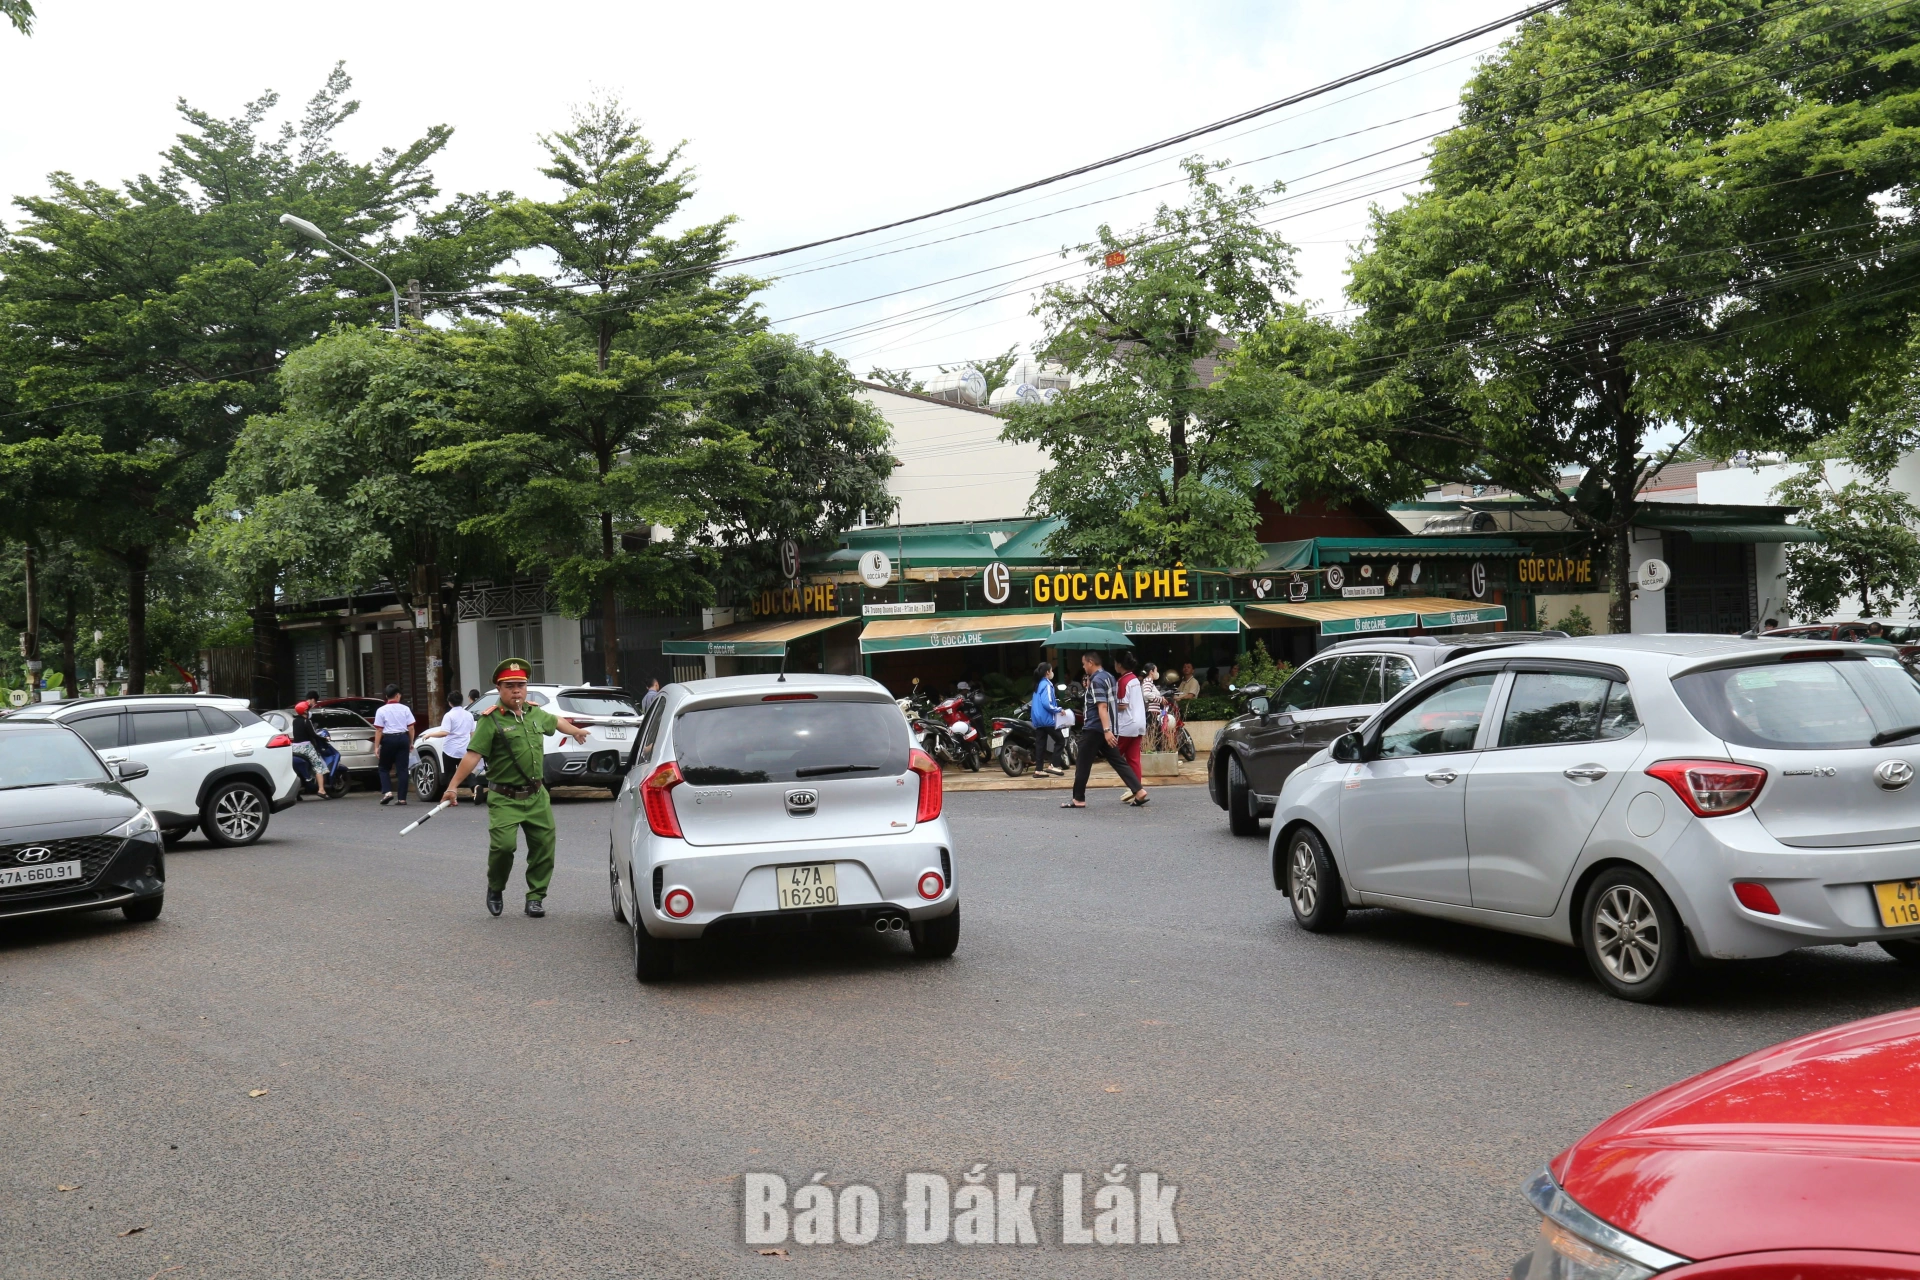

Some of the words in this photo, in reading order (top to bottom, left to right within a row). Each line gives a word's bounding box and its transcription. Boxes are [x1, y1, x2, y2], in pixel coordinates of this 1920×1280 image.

[1519, 552, 1545, 583] GÓC
[1094, 564, 1129, 600] CÀ
[1135, 561, 1189, 599] PHÊ
[804, 577, 838, 613] PHÊ
[1136, 621, 1150, 632] GÓC
[1151, 621, 1161, 632] CÀ
[1163, 621, 1177, 632] PHÊ
[957, 633, 967, 645] CÀ
[694, 788, 732, 798] morning
[792, 794, 812, 805] KIA
[0, 865, 72, 884] 47A-660.91
[792, 867, 822, 886] 47A
[781, 886, 836, 907] 162.90
